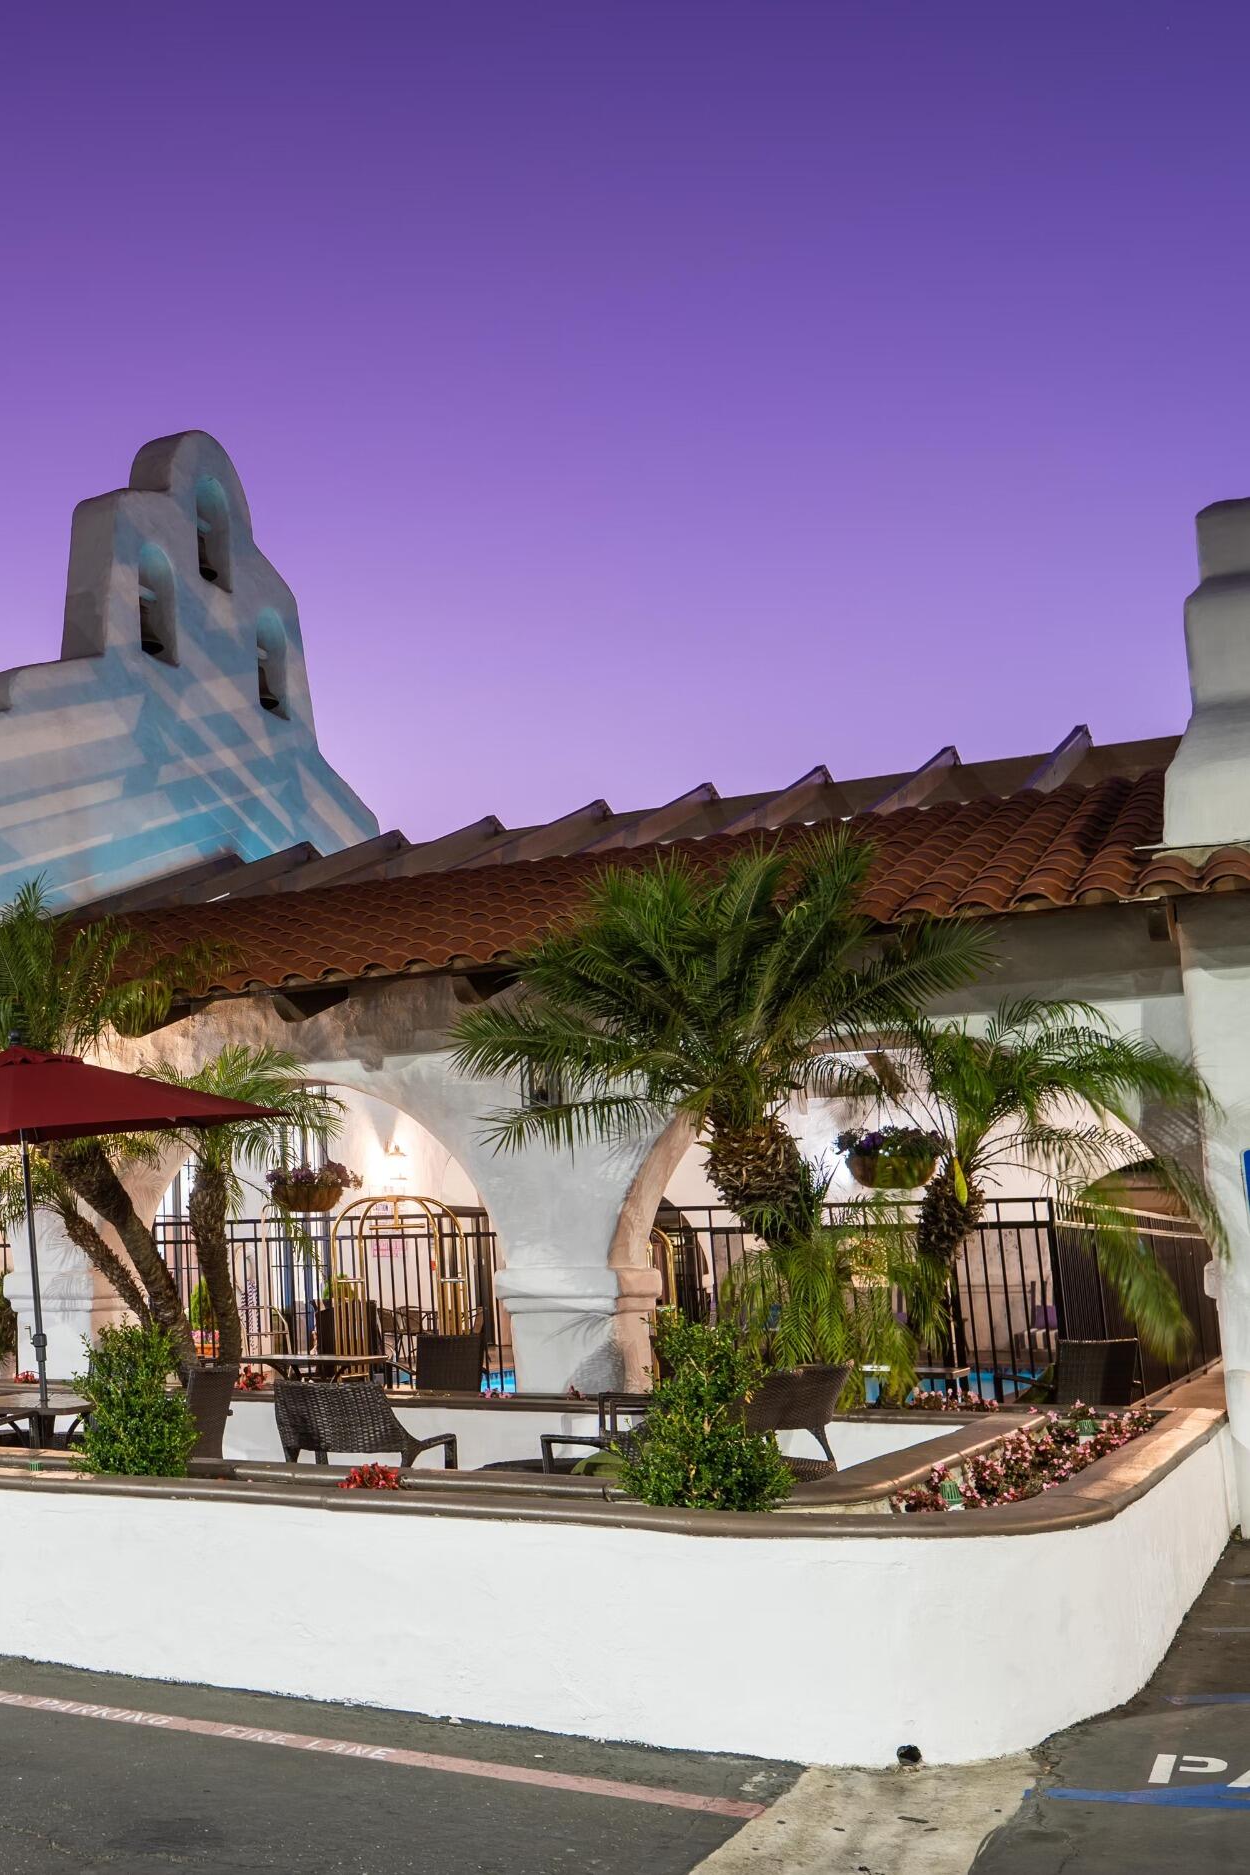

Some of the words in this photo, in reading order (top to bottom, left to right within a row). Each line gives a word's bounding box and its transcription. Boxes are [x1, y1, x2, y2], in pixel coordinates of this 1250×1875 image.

[36, 1697, 174, 1725] PARKING
[221, 1726, 296, 1746] FIRE
[302, 1739, 395, 1760] LANE
